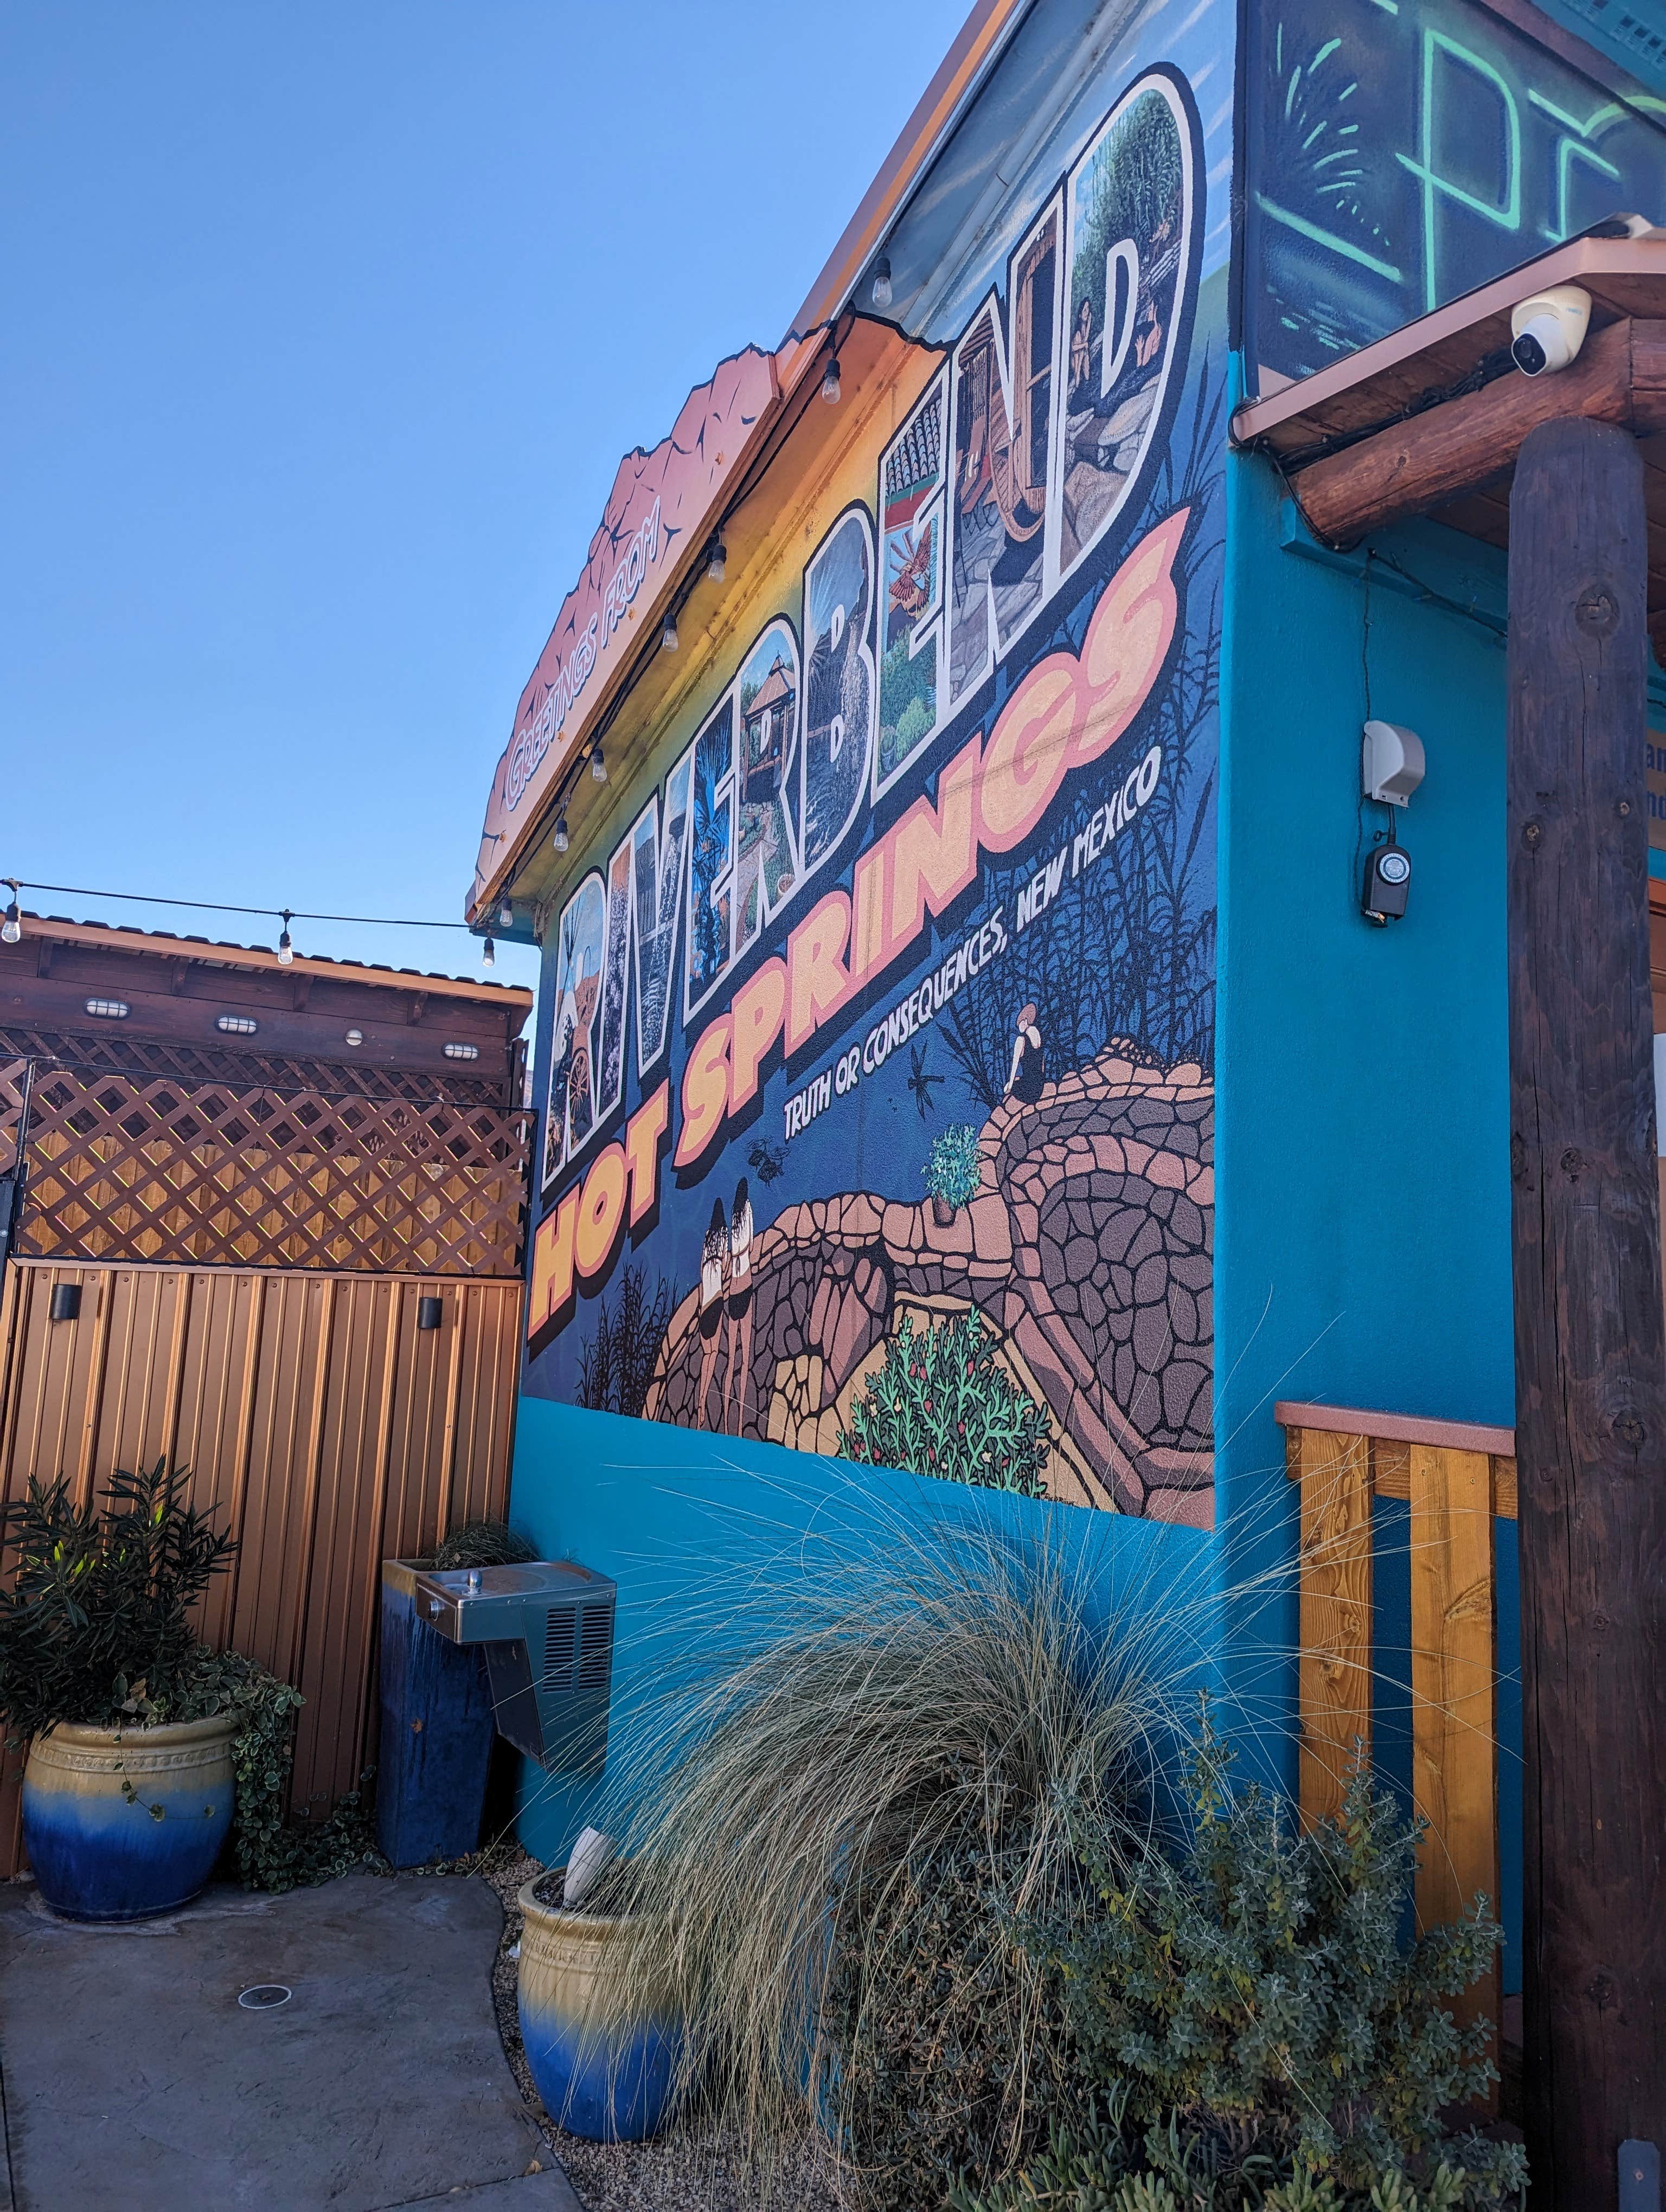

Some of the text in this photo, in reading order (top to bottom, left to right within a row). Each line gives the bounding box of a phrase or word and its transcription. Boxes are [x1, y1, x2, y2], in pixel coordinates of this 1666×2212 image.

[505, 494, 661, 812] GREETINGS FROM
[527, 507, 1189, 1341] HOT SPRINGS
[541, 70, 1195, 1194] RIVERBEND
[783, 745, 1162, 1140] TRUTH OR CONSEQUENCES, NEW MEXICO
